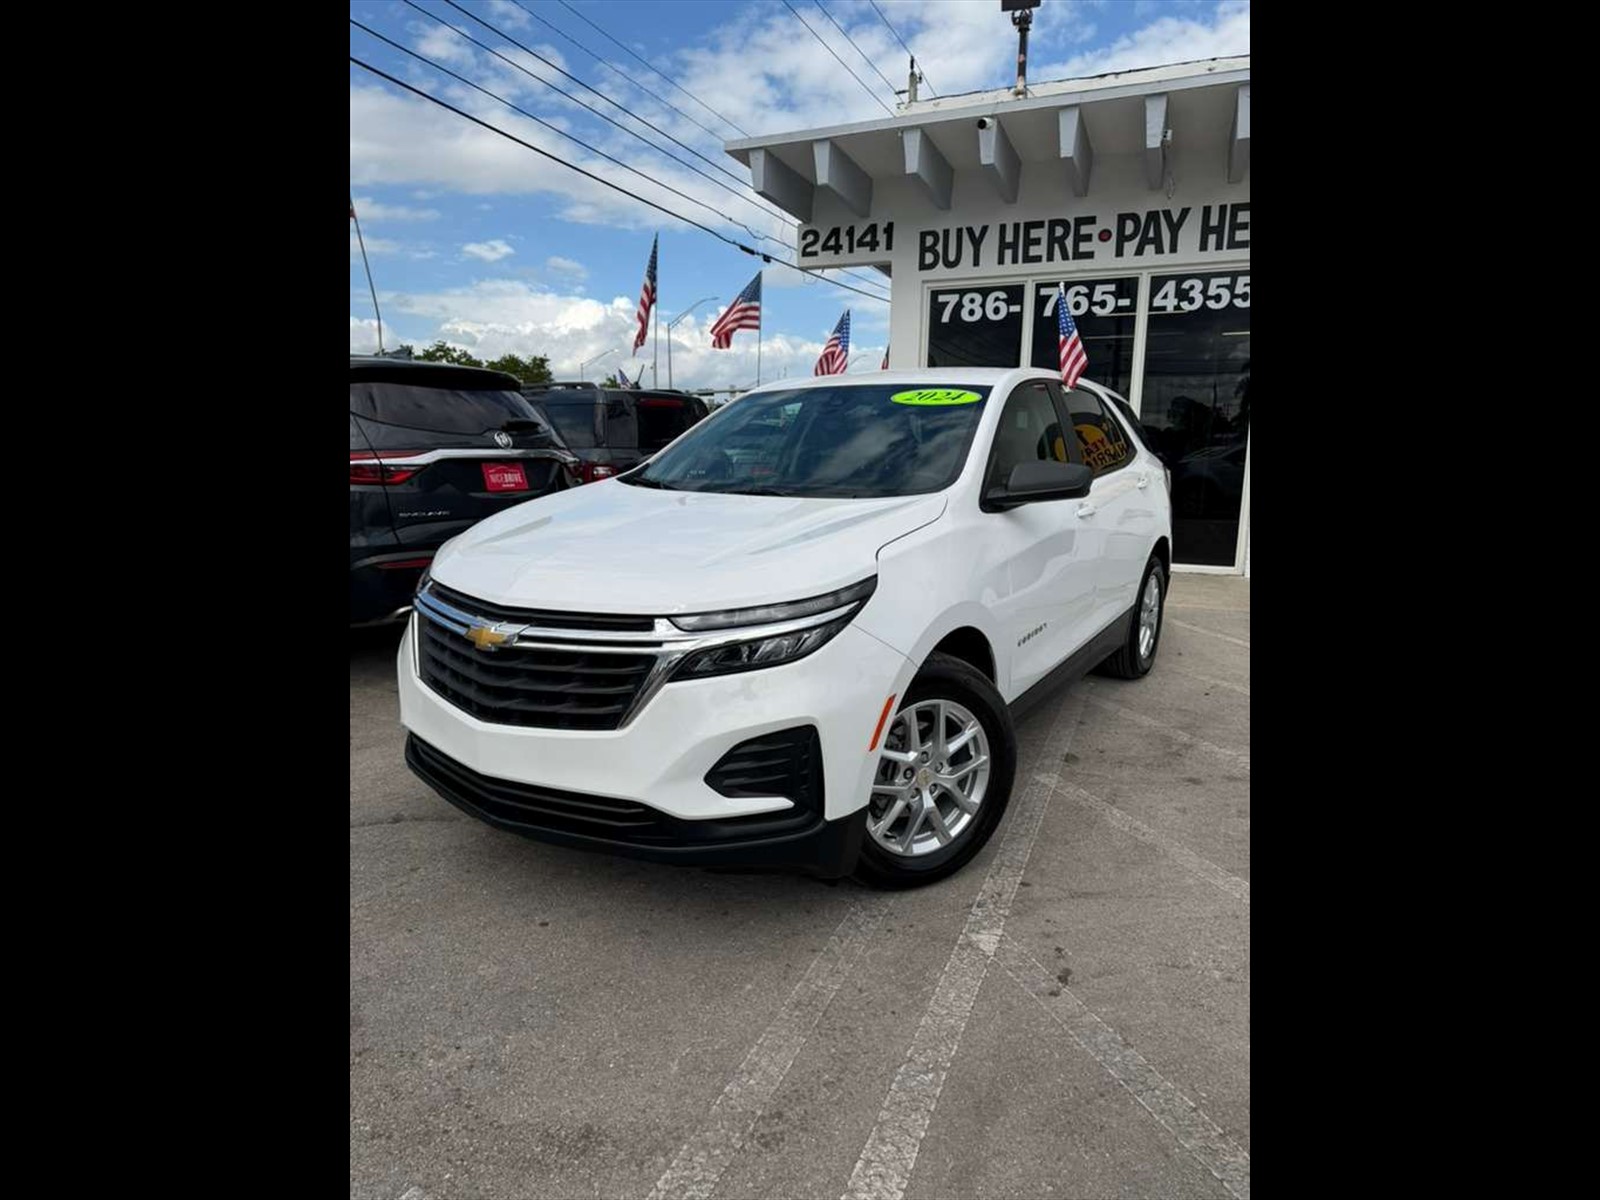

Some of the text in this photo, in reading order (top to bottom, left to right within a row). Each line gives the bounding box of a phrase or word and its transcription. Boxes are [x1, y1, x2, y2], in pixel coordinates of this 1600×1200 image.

[801, 221, 894, 257] 24141
[918, 224, 989, 271] BUY
[998, 215, 1096, 266] HERE
[1114, 206, 1192, 258] PAY
[937, 276, 1250, 323] 786- 765- 4355
